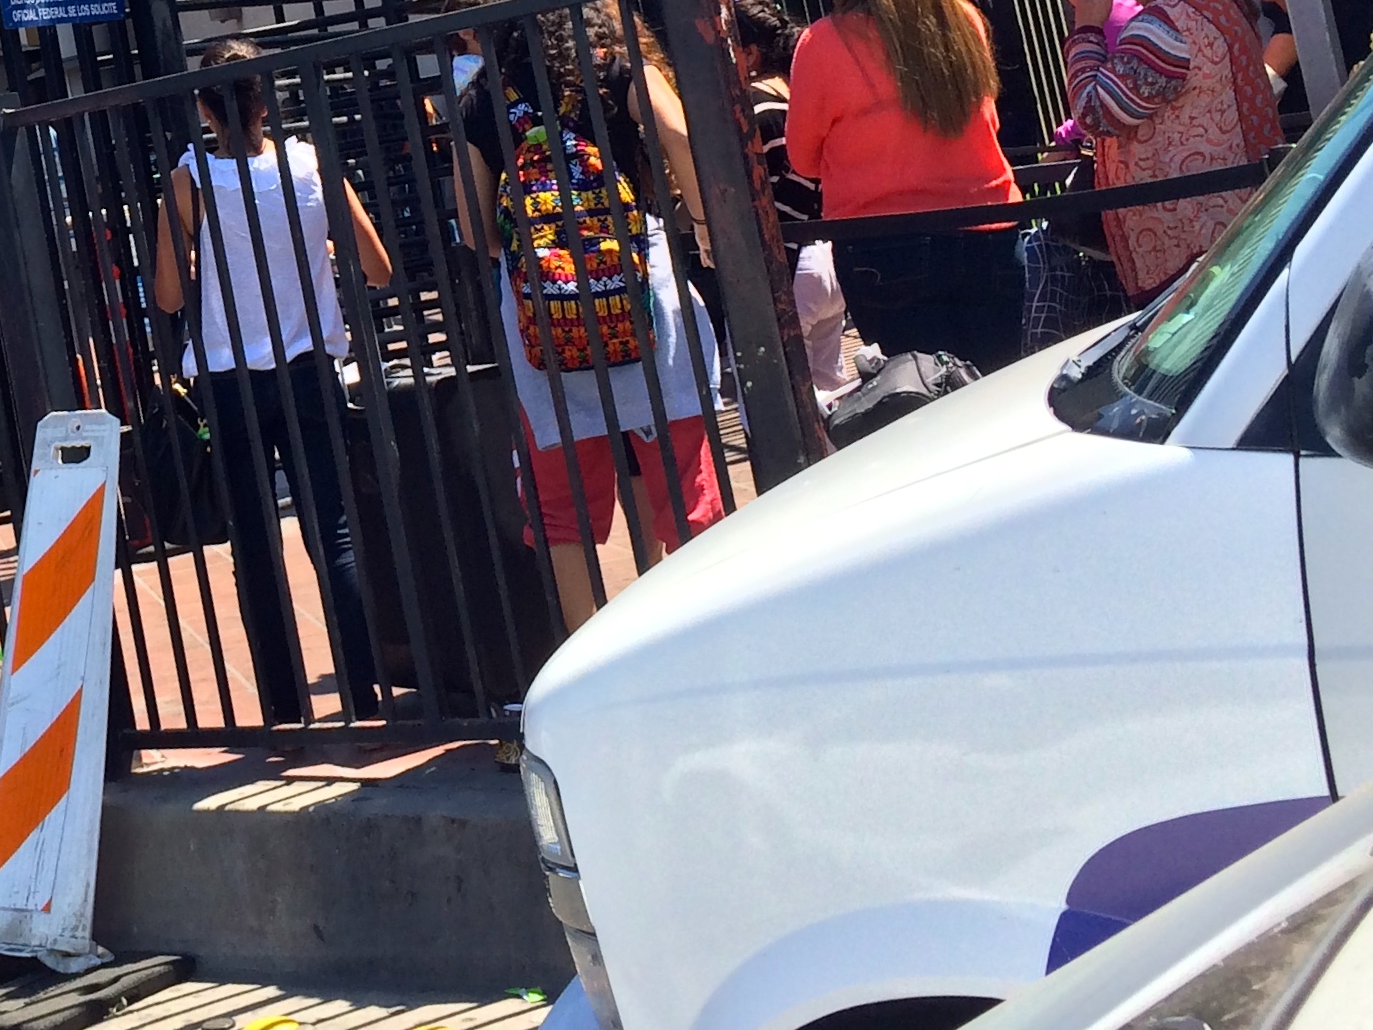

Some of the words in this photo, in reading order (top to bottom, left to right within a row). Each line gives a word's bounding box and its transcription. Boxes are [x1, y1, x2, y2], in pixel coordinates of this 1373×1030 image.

[12, 8, 38, 22] OFICIAL
[38, 6, 68, 20] FEDERAL
[67, 5, 77, 17] SE
[77, 4, 90, 16] LOS
[90, 2, 118, 15] SOLICITE
